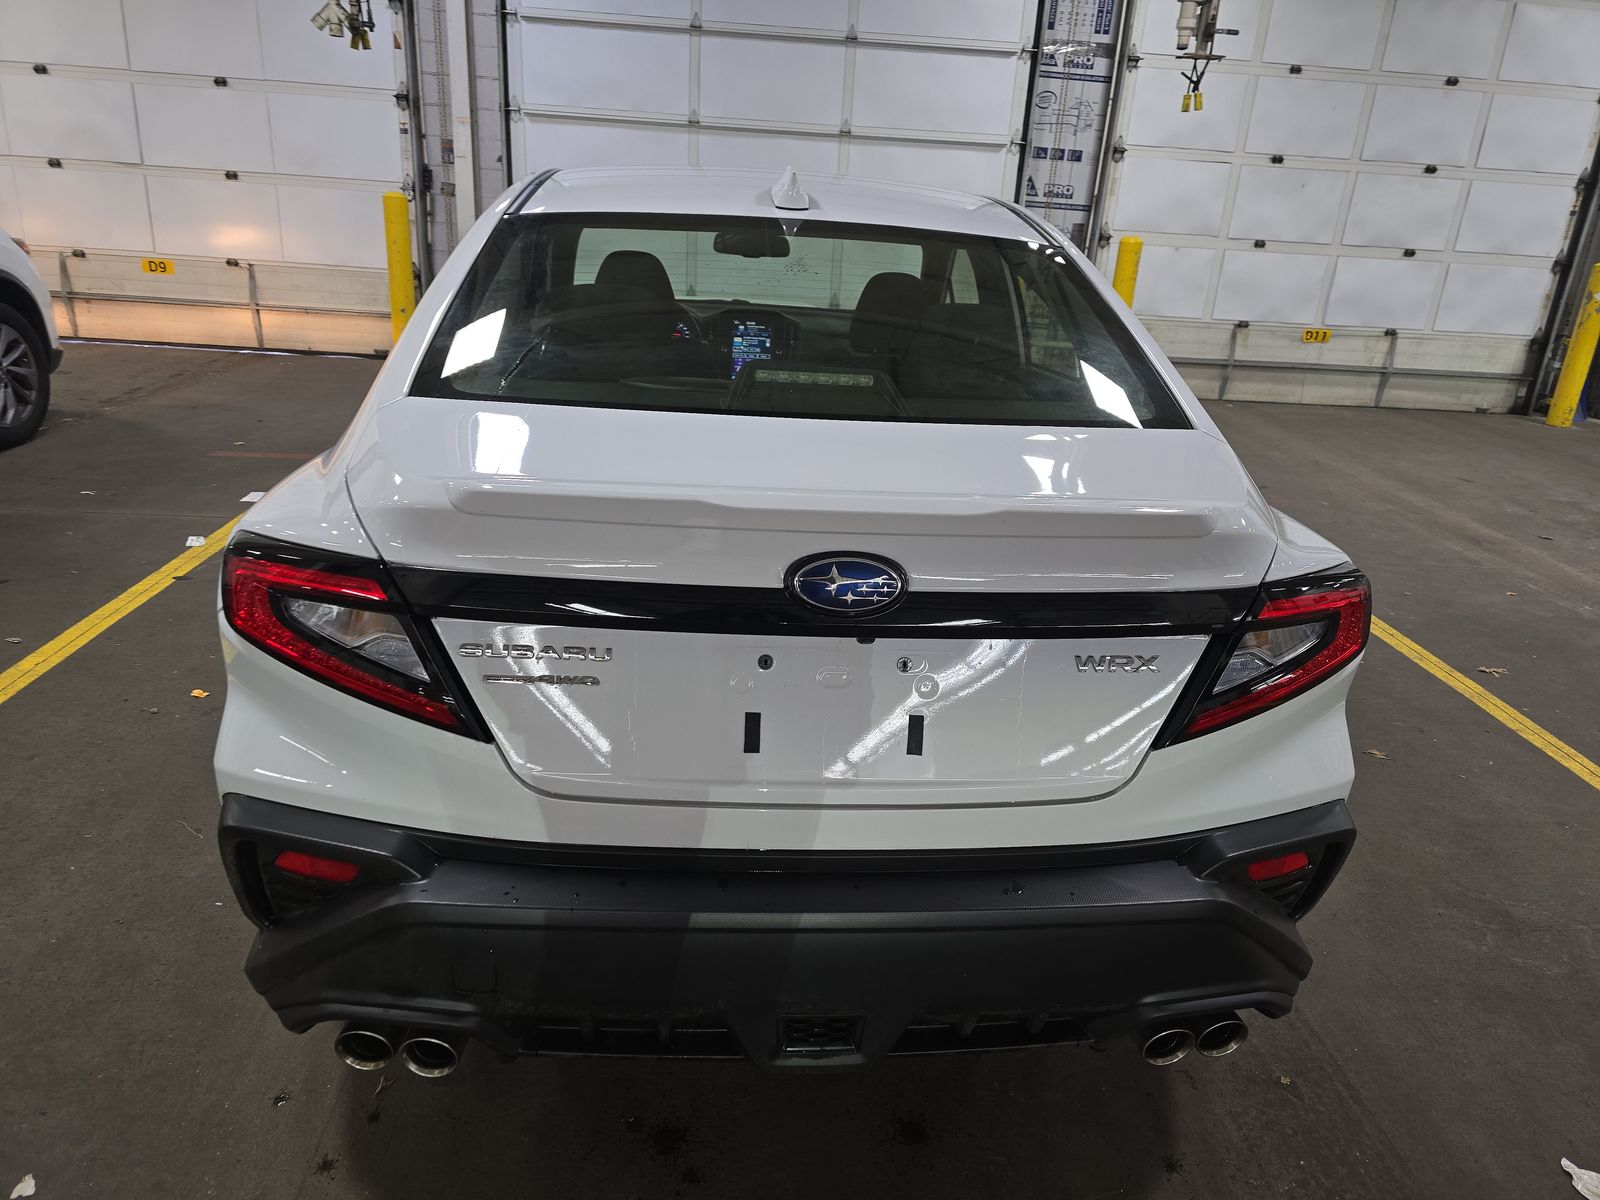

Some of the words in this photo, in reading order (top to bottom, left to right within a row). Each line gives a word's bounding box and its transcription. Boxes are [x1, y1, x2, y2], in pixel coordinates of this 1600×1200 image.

[1064, 55, 1094, 65] PRO
[1044, 184, 1074, 195] PRO
[148, 260, 167, 273] D9
[1305, 330, 1327, 341] D11
[458, 643, 613, 662] SUBARU
[1073, 654, 1160, 673] WRX
